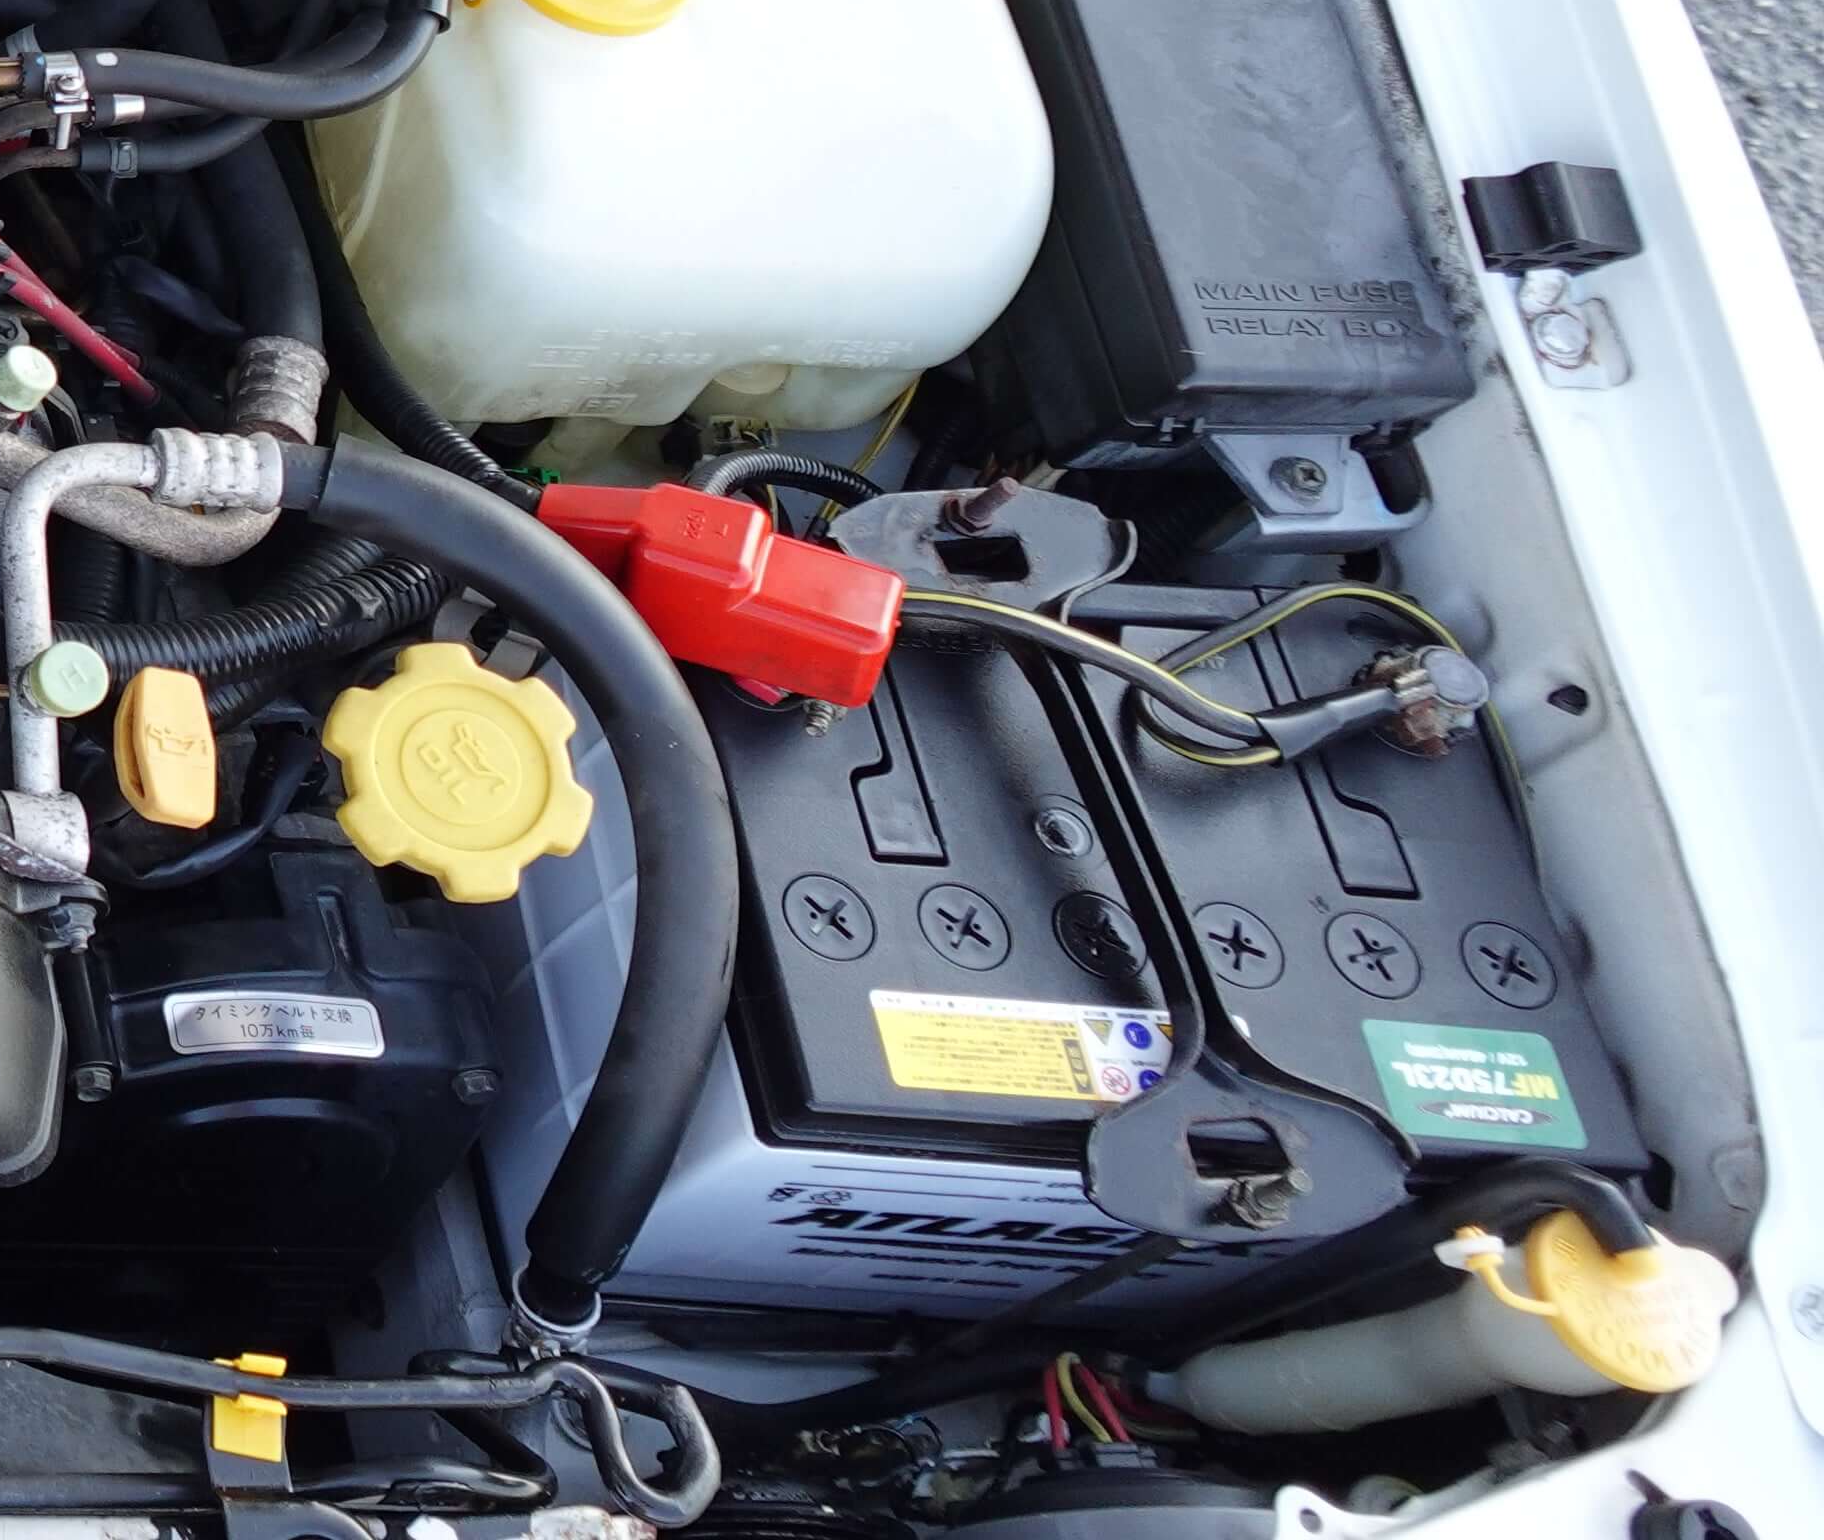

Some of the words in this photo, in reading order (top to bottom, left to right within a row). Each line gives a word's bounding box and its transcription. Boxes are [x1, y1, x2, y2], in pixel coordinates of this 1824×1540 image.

[1193, 281, 1304, 302] MAIN
[1310, 281, 1418, 304] FUSE
[1204, 316, 1327, 337] RELAY
[1342, 317, 1426, 339] BOX
[58, 659, 90, 693] H
[416, 741, 469, 805] OIL
[194, 1003, 353, 1024] タイミングベルト交換
[240, 1023, 316, 1039] 10万km毎
[1390, 1060, 1561, 1101] MF75D23L
